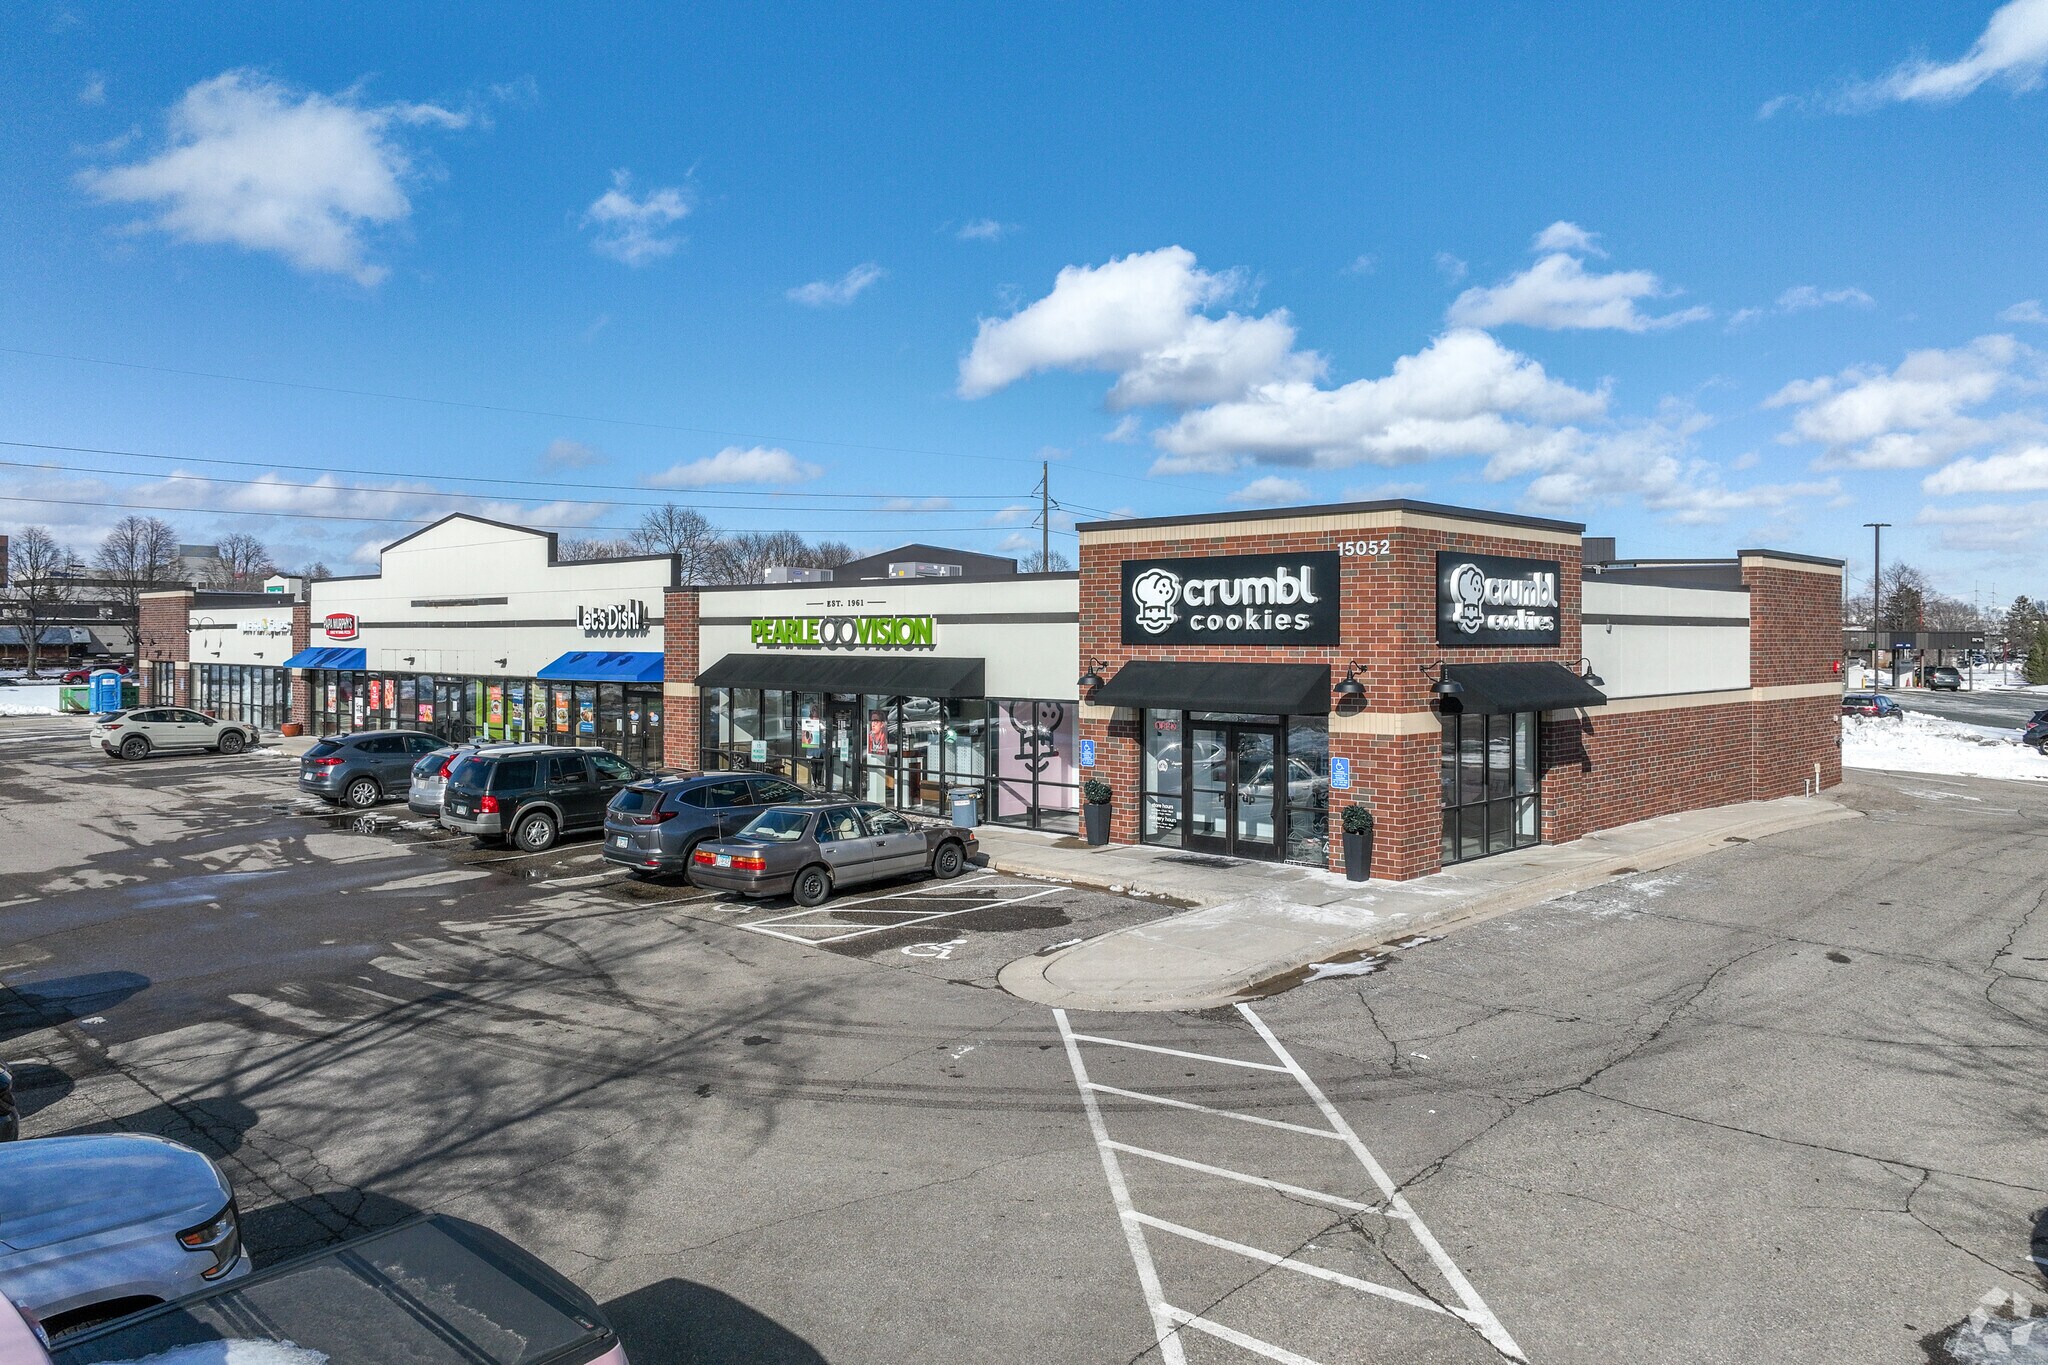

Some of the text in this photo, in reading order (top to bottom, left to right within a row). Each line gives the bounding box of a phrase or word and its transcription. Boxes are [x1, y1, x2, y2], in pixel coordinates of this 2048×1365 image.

[1337, 539, 1390, 556] 15052
[1183, 565, 1318, 607] crumbl
[1485, 571, 1558, 608] crumbl
[576, 599, 640, 630] Let's Dish!
[826, 599, 864, 608] EST. 1961
[751, 617, 934, 645] PEARLE VISION
[1190, 608, 1312, 631] cookies
[1487, 609, 1554, 631] cookies
